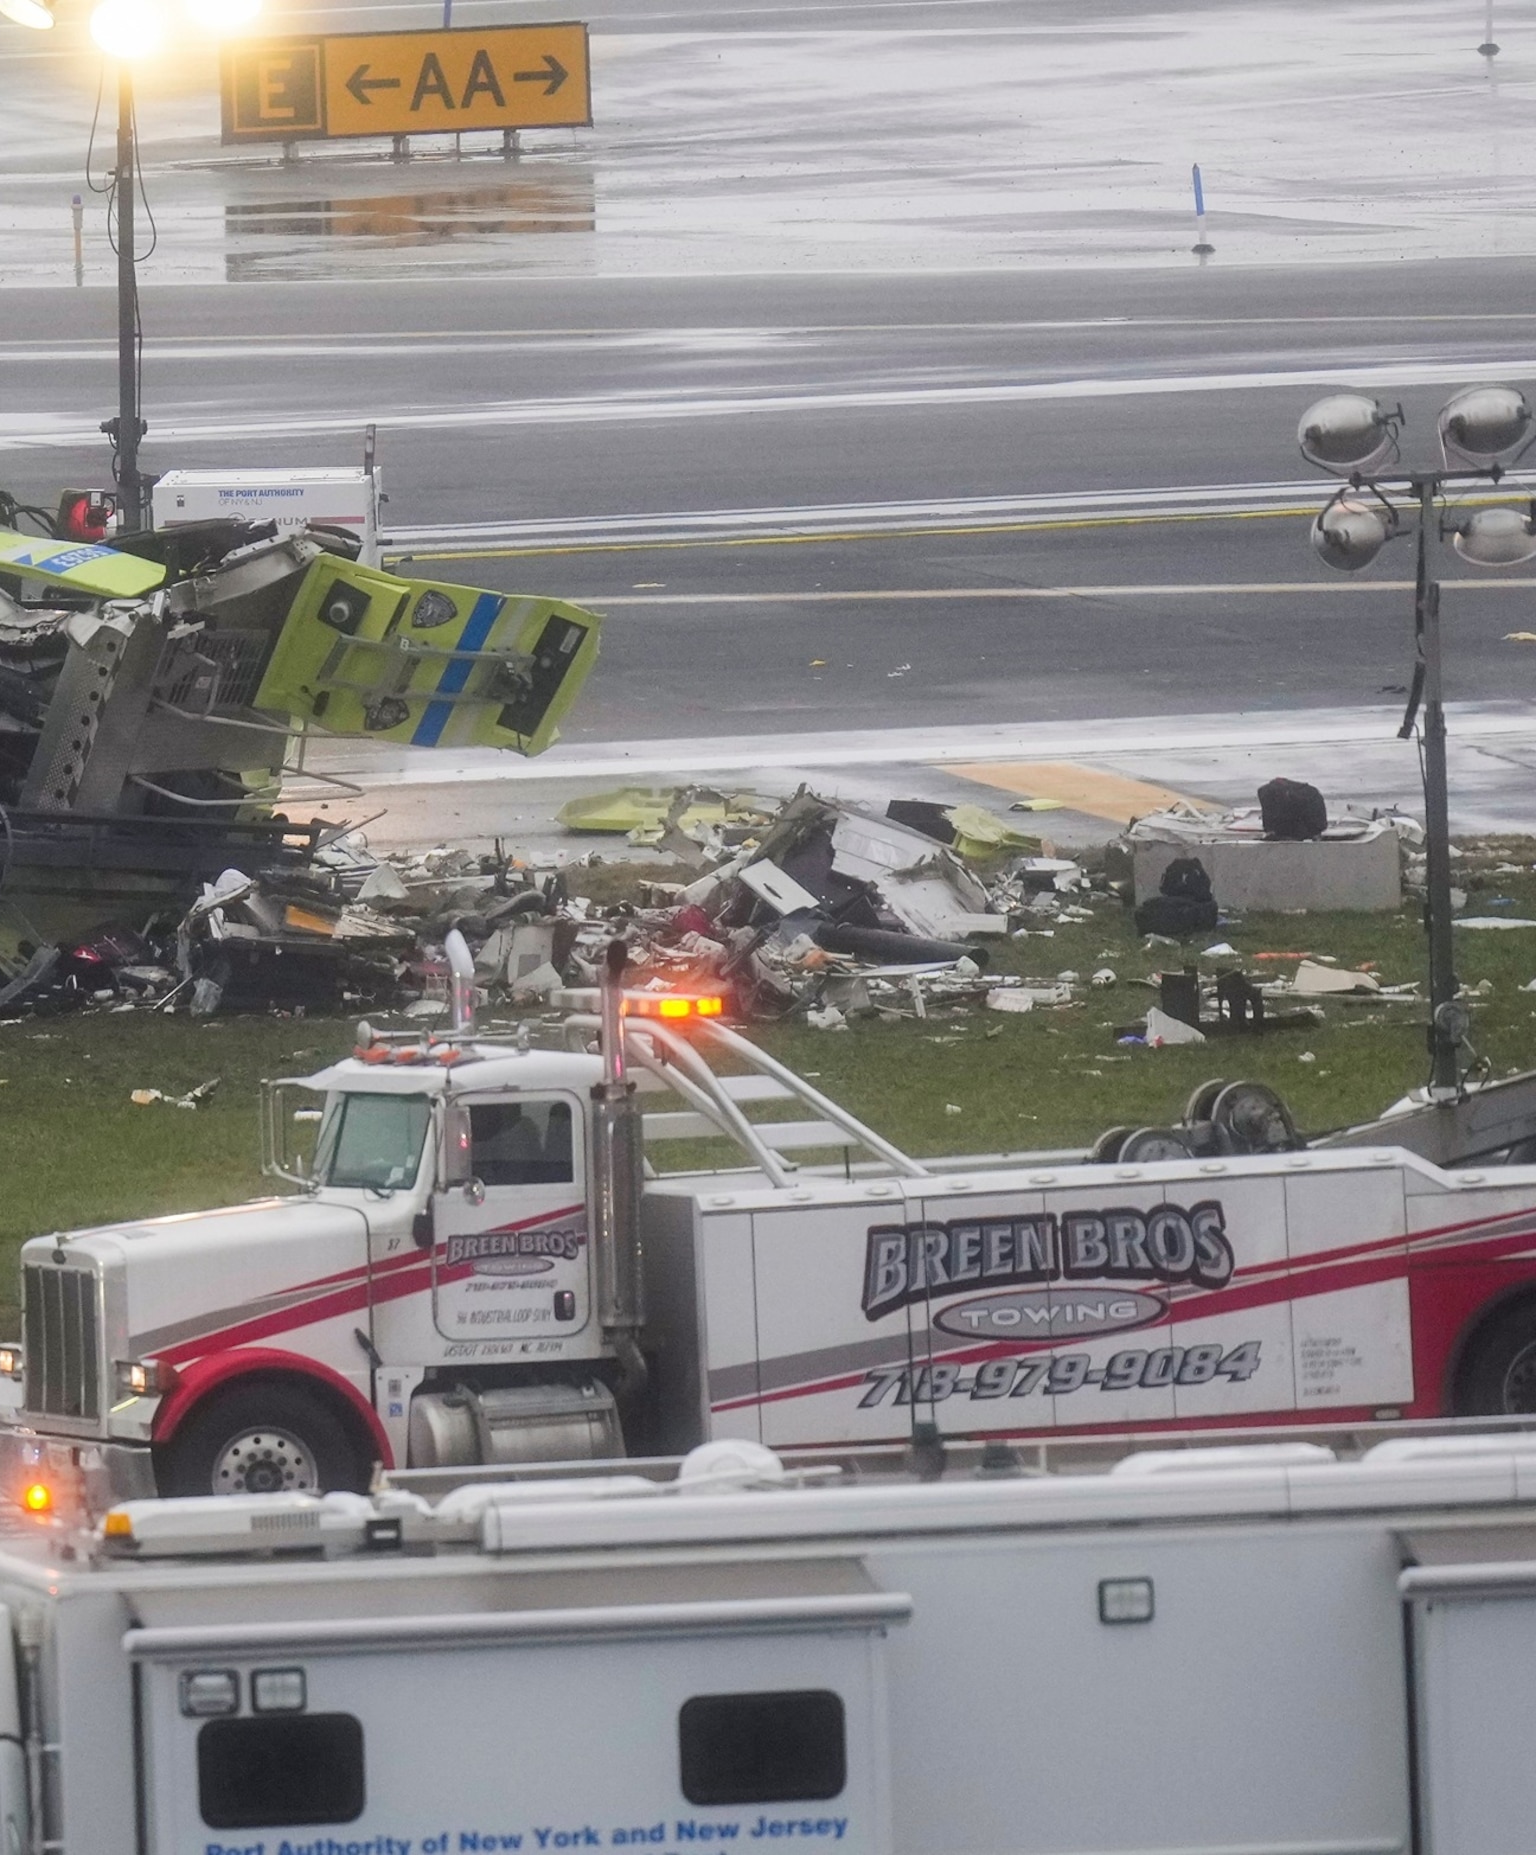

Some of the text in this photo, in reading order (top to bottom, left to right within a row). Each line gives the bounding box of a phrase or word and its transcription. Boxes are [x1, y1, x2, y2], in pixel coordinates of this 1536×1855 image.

[260, 49, 507, 119] E AA
[218, 488, 305, 498] THE PORT AUTHORITY
[447, 1230, 578, 1265] BREEN BROS
[864, 1201, 1234, 1320] BREEN BROS
[960, 1300, 1138, 1329] TOWING
[857, 1341, 1262, 1409] 718-979-9084
[206, 1815, 849, 1855] Port Authority of New York and New Jersey
